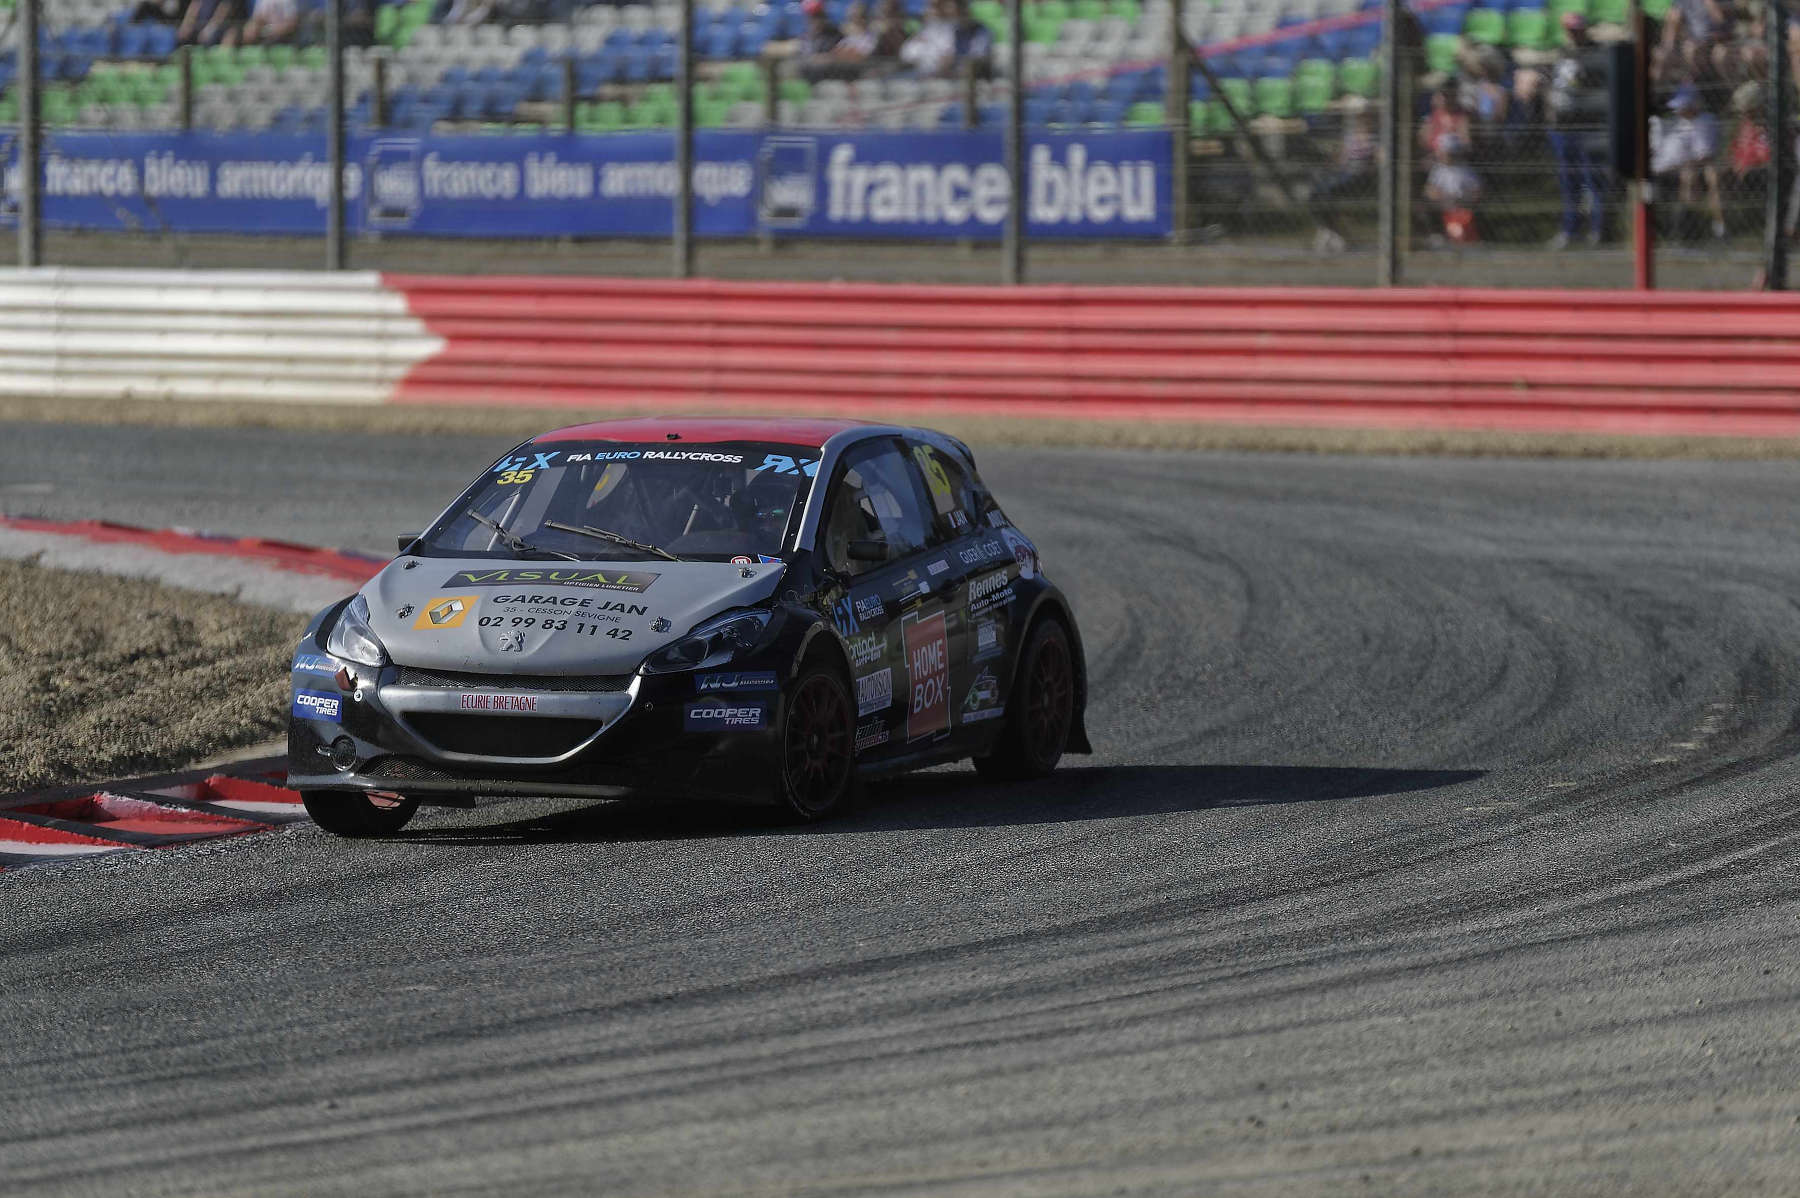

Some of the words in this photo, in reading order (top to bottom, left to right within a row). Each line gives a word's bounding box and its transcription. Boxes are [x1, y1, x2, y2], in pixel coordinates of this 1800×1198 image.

[46, 152, 136, 197] france
[145, 151, 210, 198] bleu
[423, 152, 521, 198] france
[524, 152, 595, 198] bleu
[826, 143, 1011, 223] france
[1028, 144, 1156, 223] bleu
[566, 452, 592, 463] FIA
[594, 451, 641, 462] EURO
[642, 451, 744, 465] RALLYCROSS
[496, 469, 536, 485] 35
[563, 580, 600, 588] OPTICIEN
[601, 584, 640, 592] LUNETIER
[968, 569, 1008, 602] Rennes
[493, 594, 594, 608] GARAGE
[596, 599, 649, 617] JAN
[855, 599, 867, 613] FIA
[970, 588, 1013, 612] Auto-Moto
[503, 606, 517, 614] 35
[527, 606, 573, 616] CESSON
[574, 610, 622, 624] SEVIGNE
[478, 616, 503, 628] 02
[510, 616, 537, 629] 99
[541, 618, 568, 631] 83
[576, 621, 599, 636] 11
[606, 627, 633, 641] 42
[913, 641, 945, 680] HOME
[296, 694, 340, 708] COOPER
[461, 693, 491, 710] ECURIE
[493, 694, 538, 712] BRETAGNE
[913, 672, 945, 714] BOX
[315, 705, 338, 716] TIRES
[690, 707, 762, 719] COOPER
[724, 716, 761, 725] TIRES
